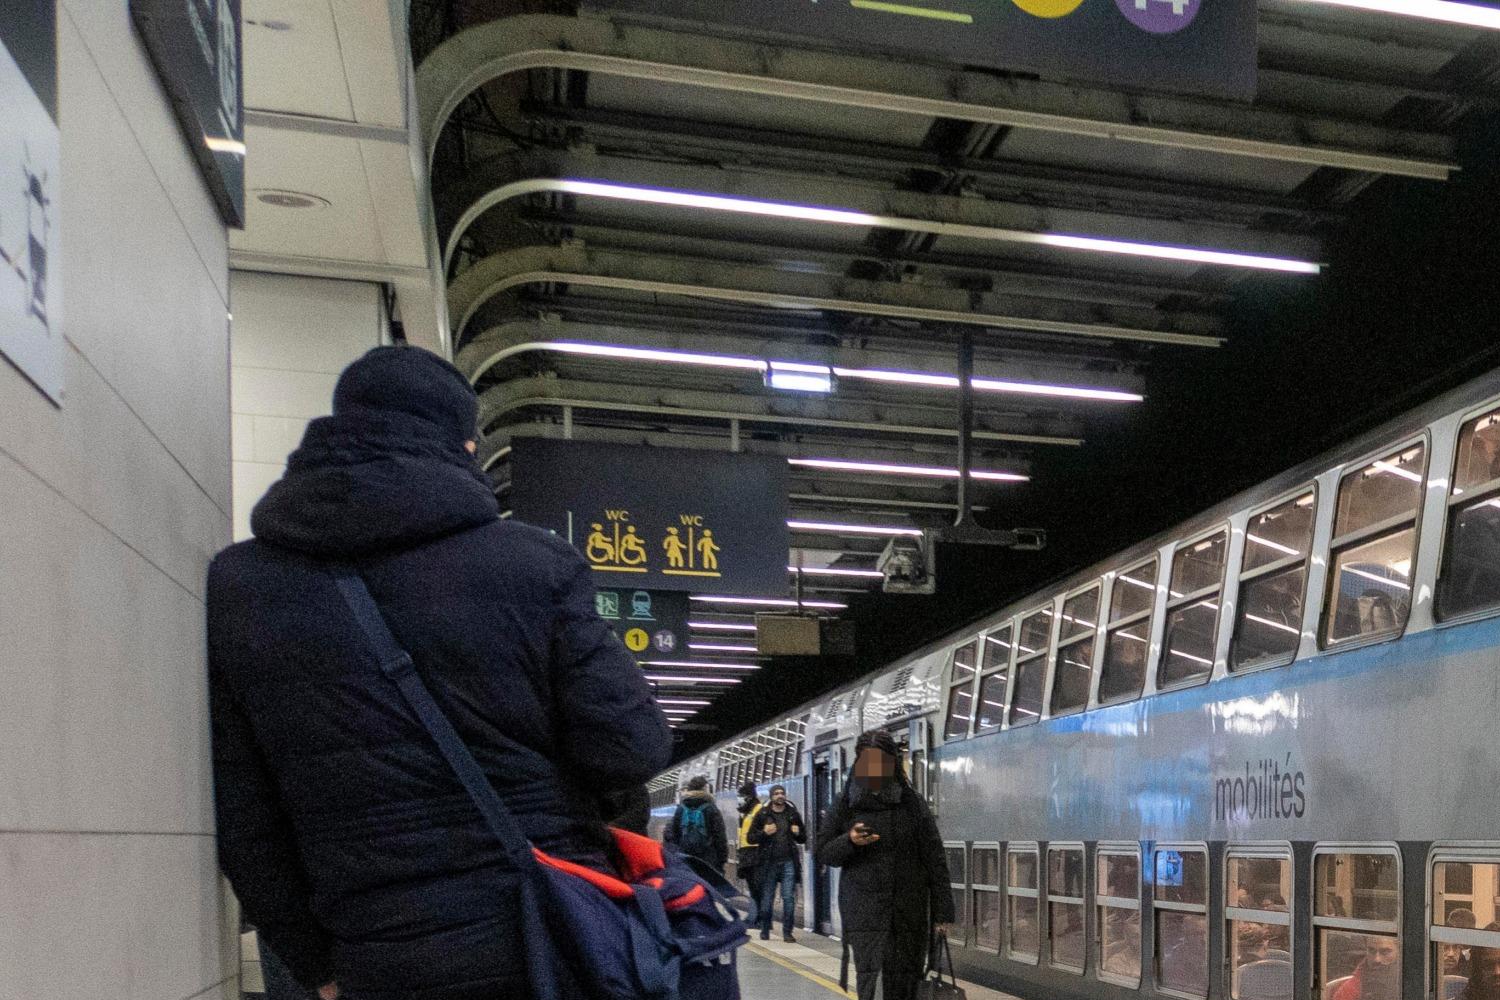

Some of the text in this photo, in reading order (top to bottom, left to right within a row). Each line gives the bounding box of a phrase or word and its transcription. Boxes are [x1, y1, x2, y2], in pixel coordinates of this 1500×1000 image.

[605, 509, 629, 521] WC
[680, 514, 703, 526] WC
[632, 633, 674, 648] 1 14
[1215, 751, 1306, 820] mobilités
